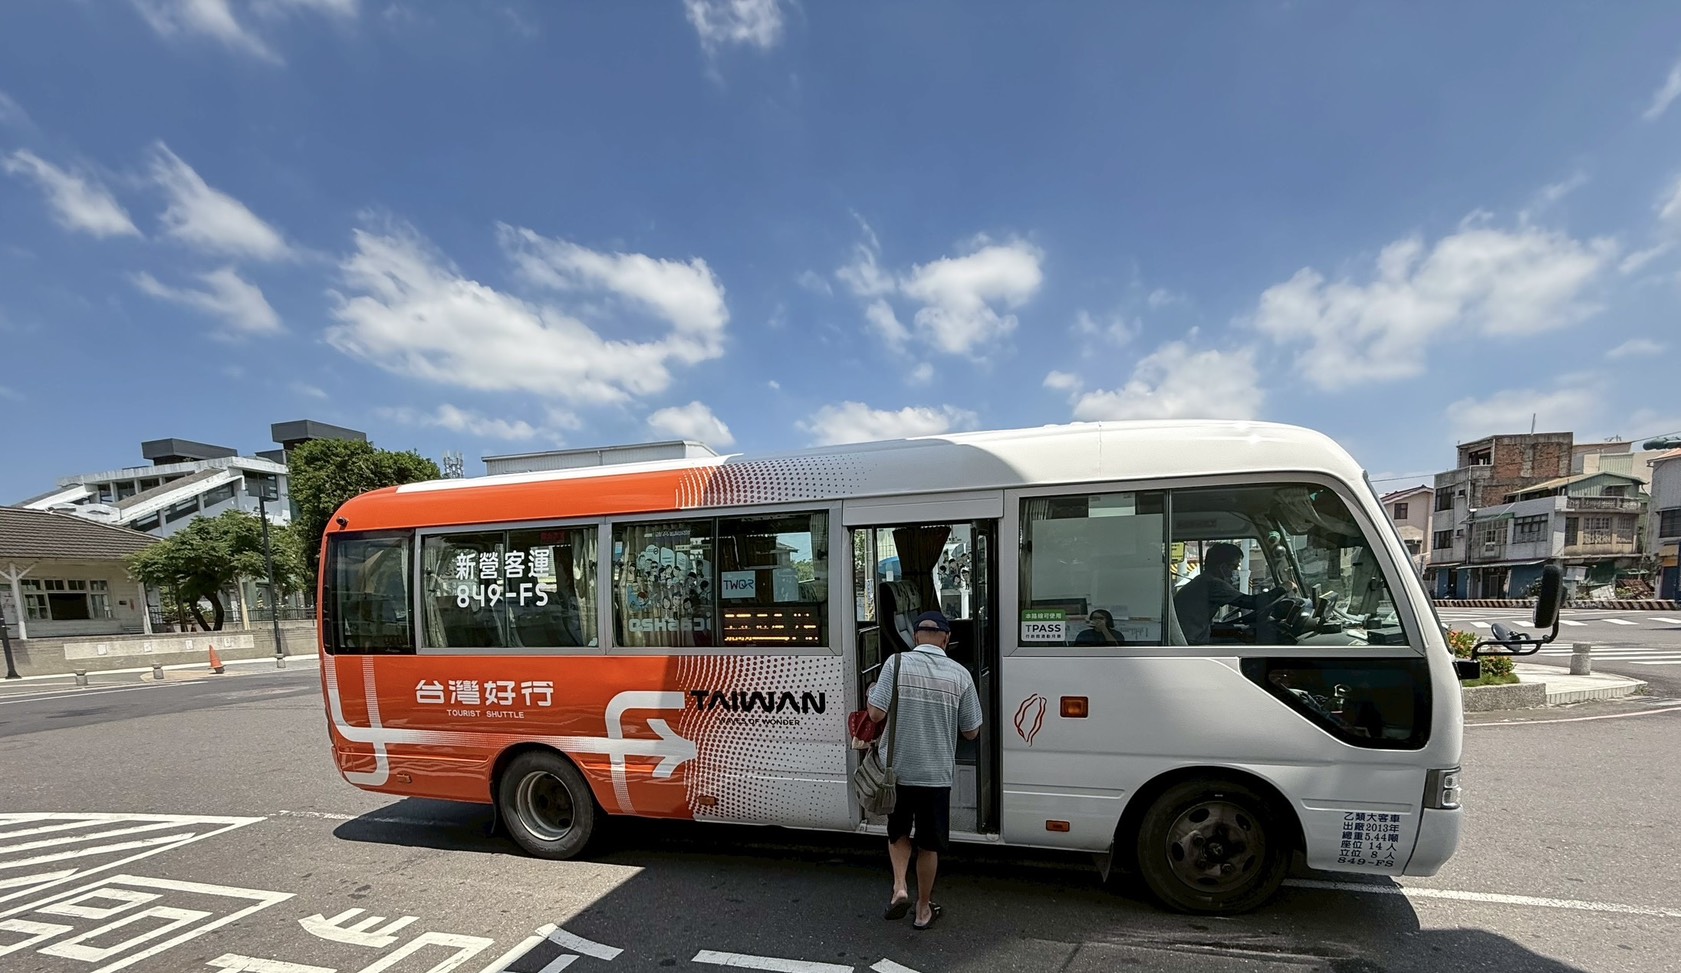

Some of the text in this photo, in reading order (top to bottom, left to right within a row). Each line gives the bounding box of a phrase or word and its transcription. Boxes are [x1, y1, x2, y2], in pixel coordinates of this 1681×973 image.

[456, 550, 550, 580] 新營客運
[456, 582, 549, 608] 849-FS
[1025, 624, 1062, 633] TPASS
[415, 680, 554, 707] 台灣好行
[690, 690, 826, 714] TAIWAN
[446, 709, 524, 719] TOURIST SHUTTLE
[762, 718, 800, 726] WONDER
[1344, 812, 1400, 823] 乙類大客車
[1343, 822, 1400, 833] 出廠2013年
[1341, 840, 1363, 849] 座位
[1369, 842, 1382, 850] 14
[1339, 849, 1361, 857] 立位
[1337, 857, 1394, 867] 849-FS
